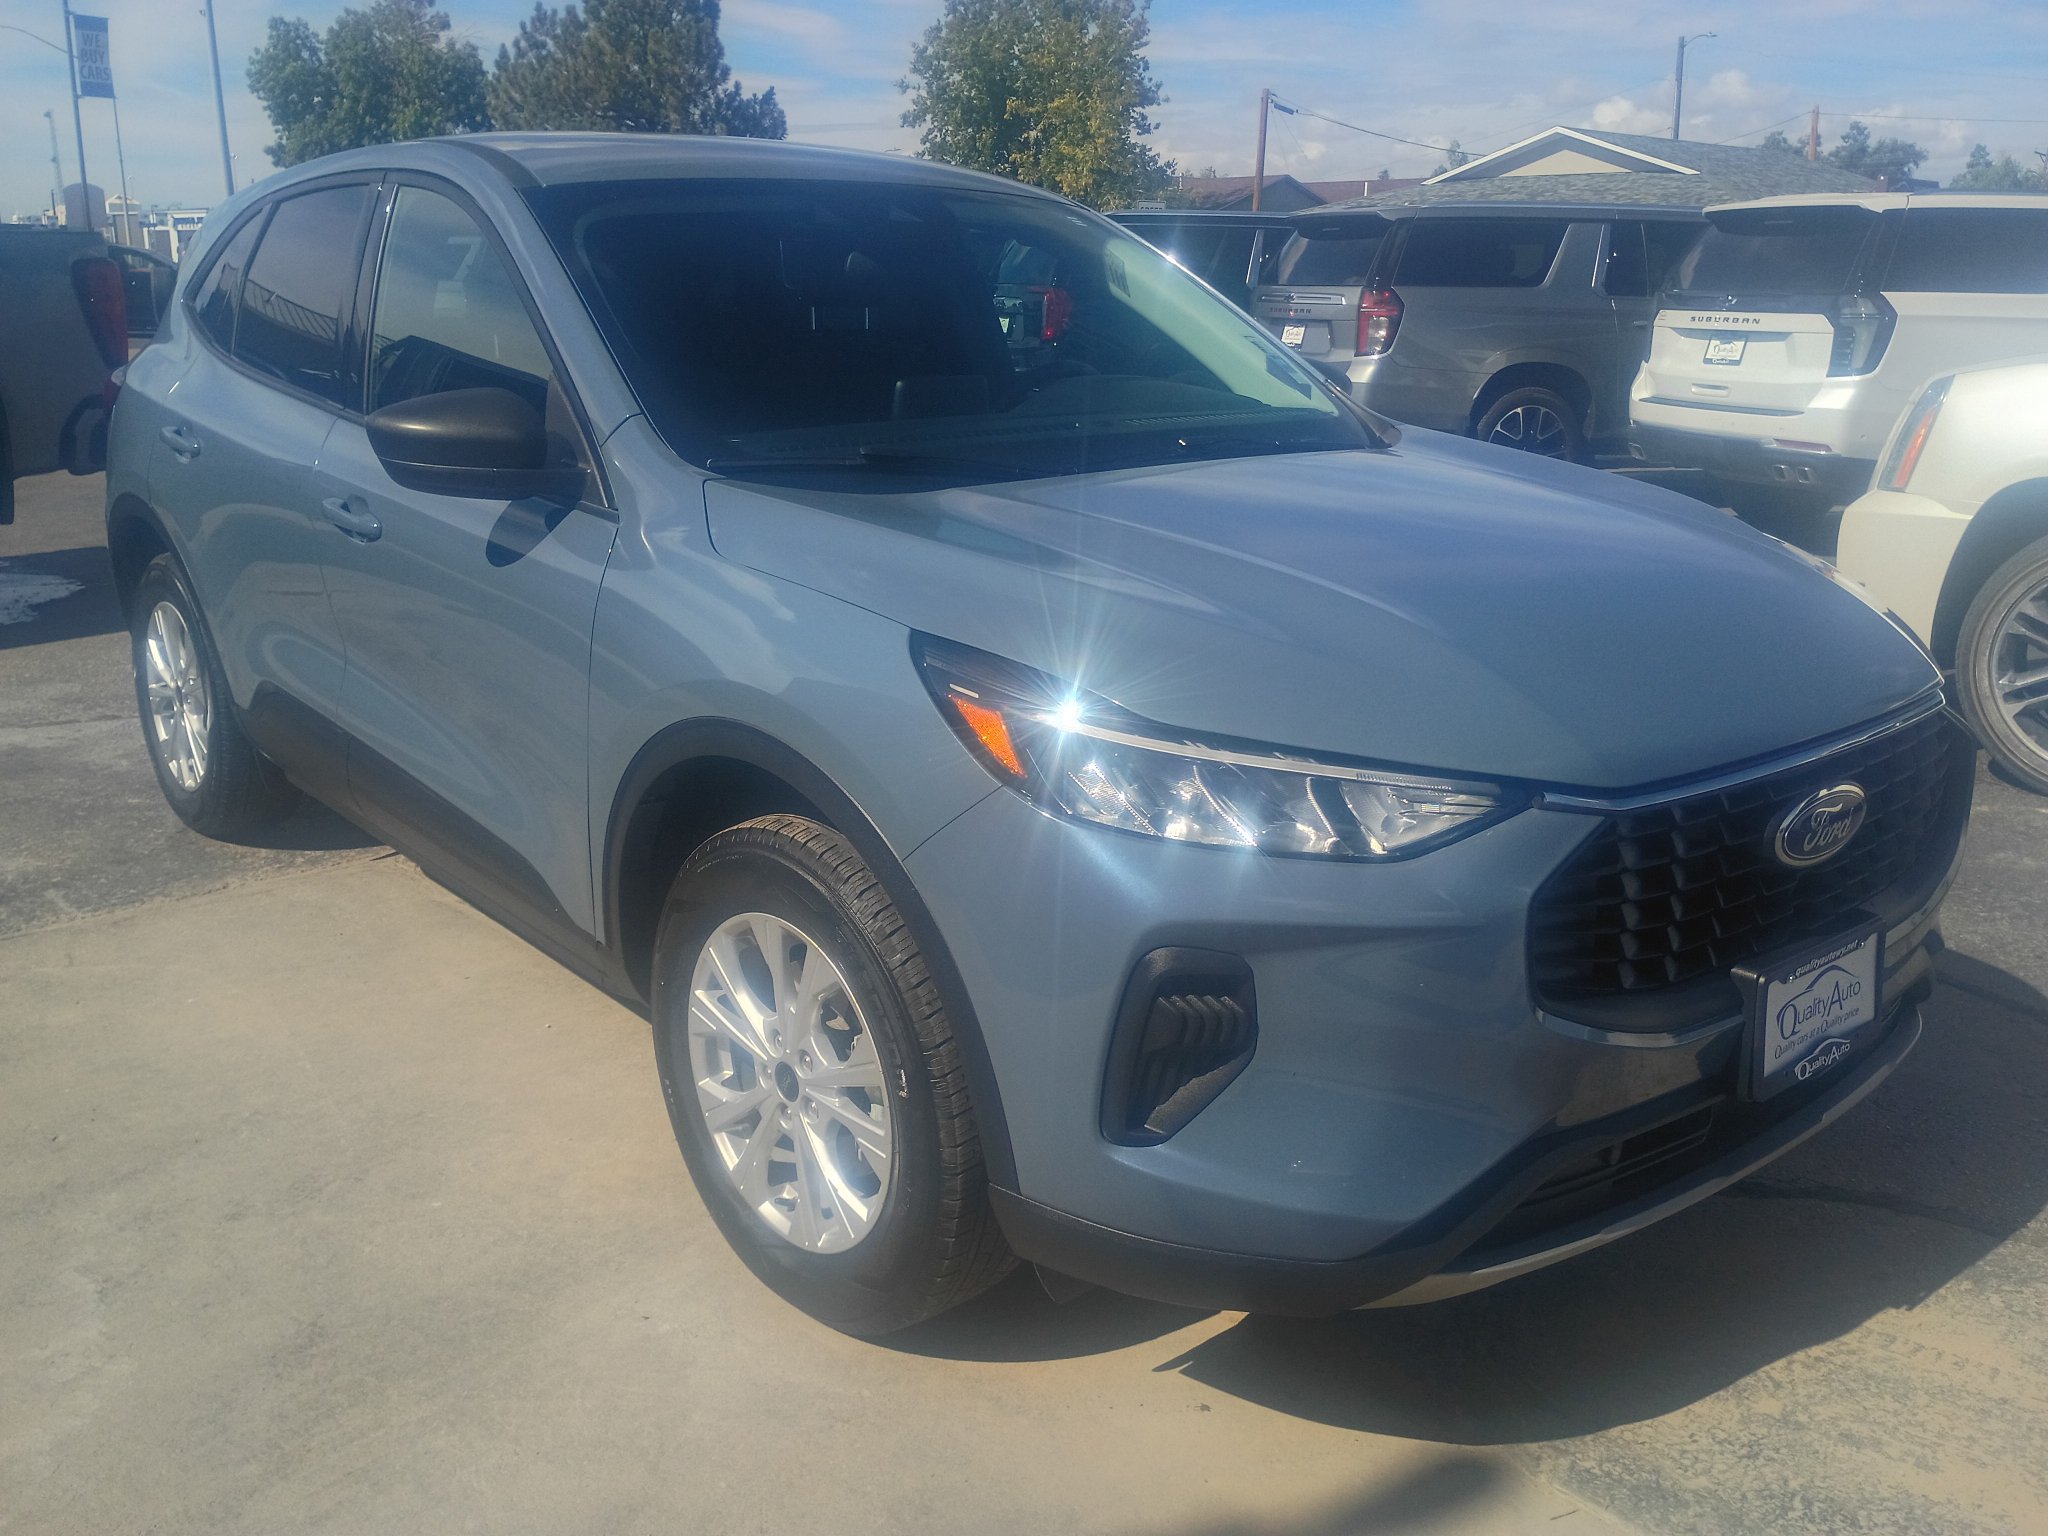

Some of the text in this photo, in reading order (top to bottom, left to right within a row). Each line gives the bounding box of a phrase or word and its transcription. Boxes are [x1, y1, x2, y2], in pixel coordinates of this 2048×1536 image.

[81, 32, 103, 48] WE
[81, 48, 105, 65] BUY
[81, 65, 110, 81] CARS
[1690, 316, 1760, 324] SUBURBAN
[1803, 803, 1854, 852] Ford
[1795, 938, 1860, 978] qualityautowy.net
[1774, 1041, 1796, 1060] Quality
[1820, 1013, 1845, 1033] Quality
[1843, 1007, 1860, 1022] price
